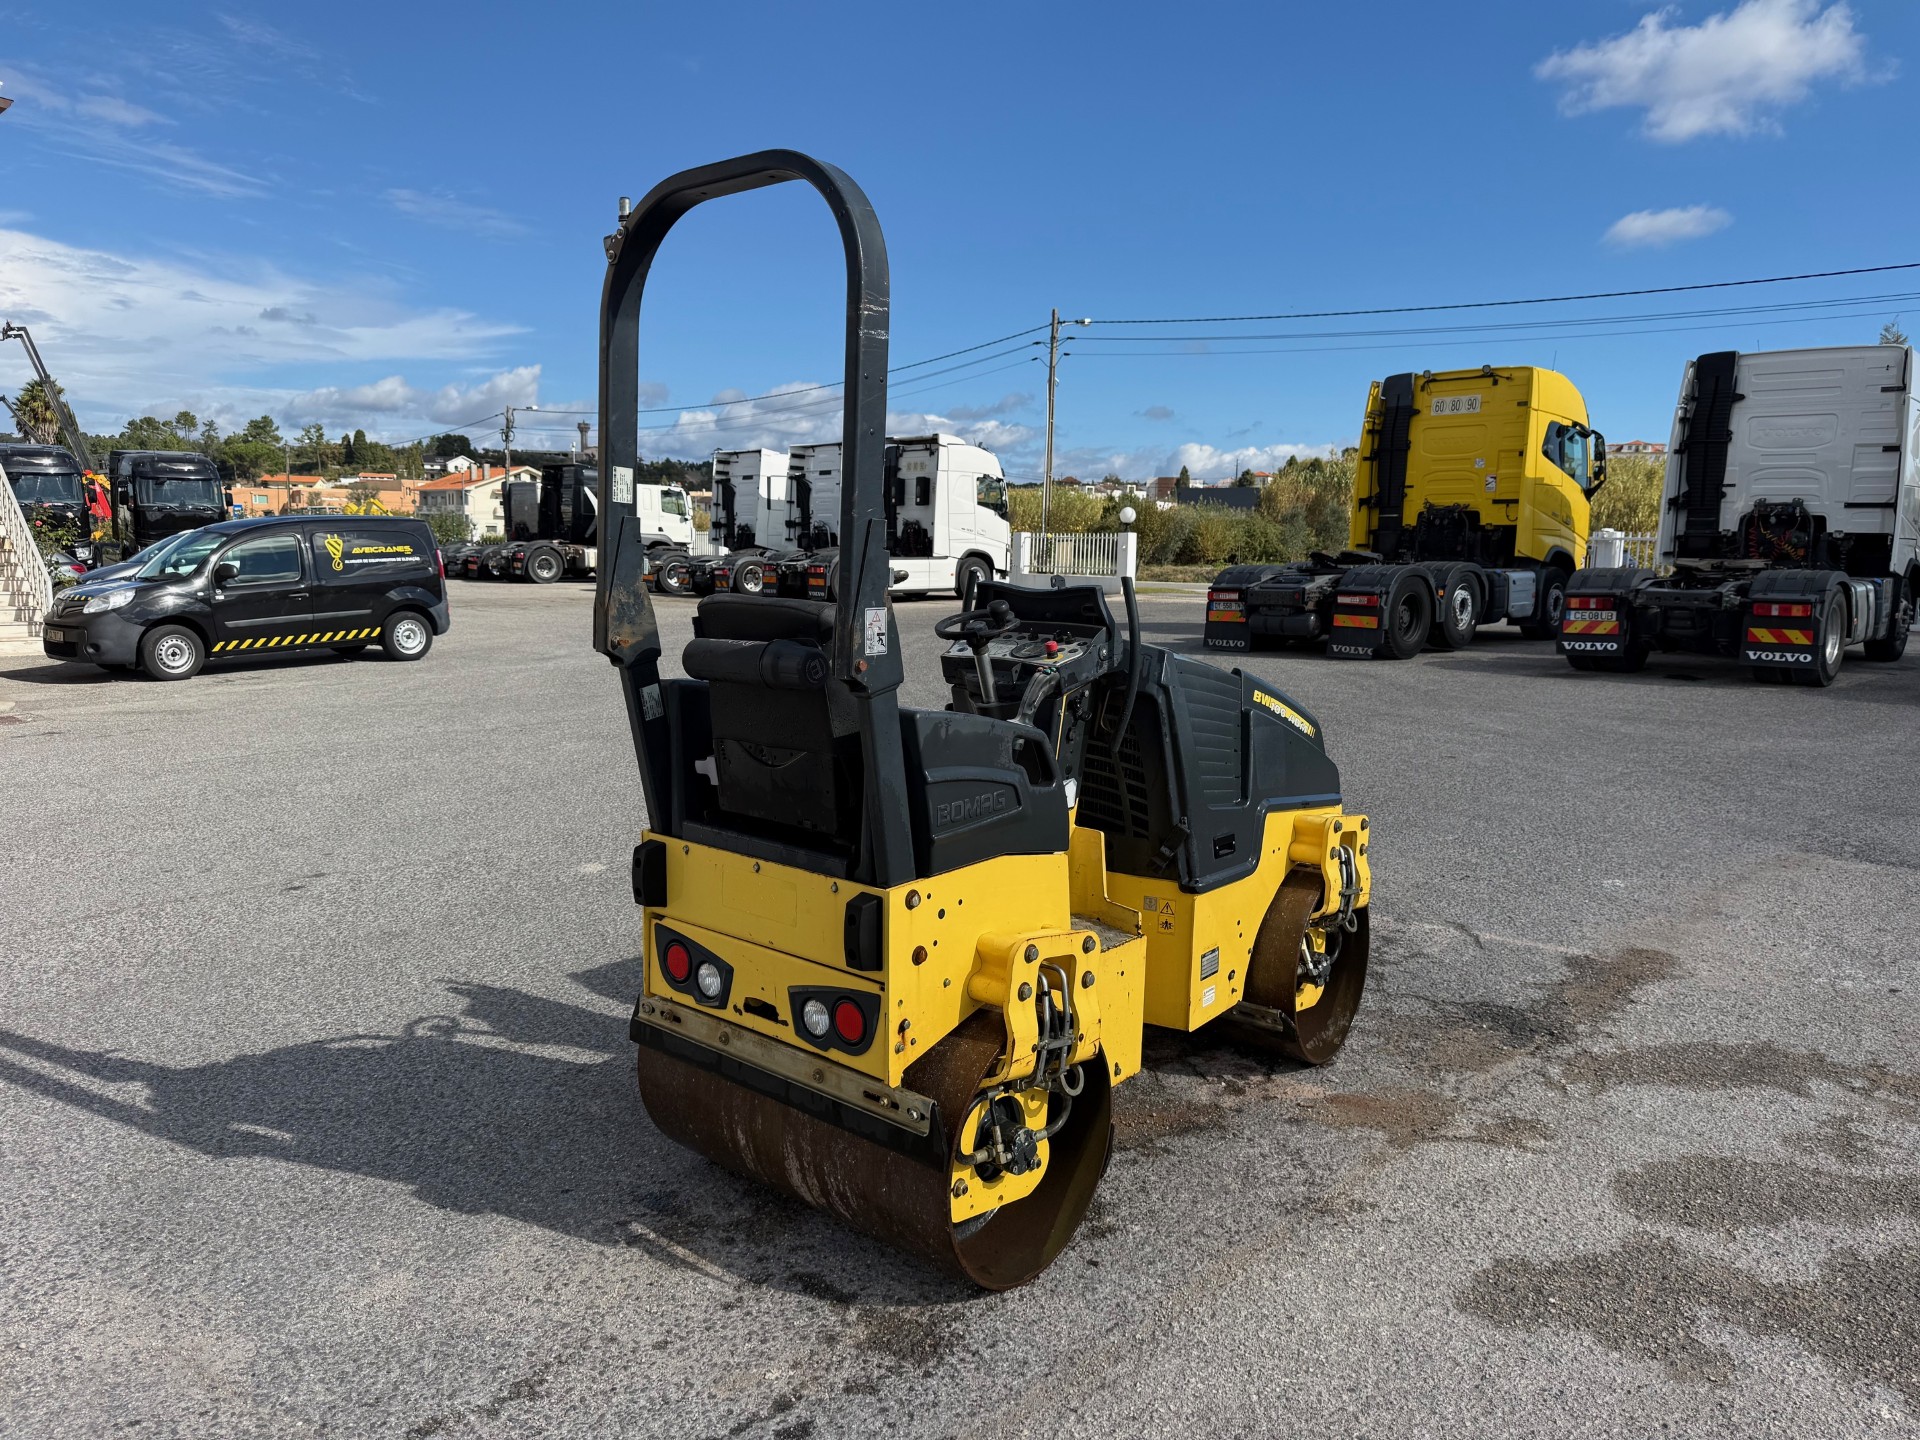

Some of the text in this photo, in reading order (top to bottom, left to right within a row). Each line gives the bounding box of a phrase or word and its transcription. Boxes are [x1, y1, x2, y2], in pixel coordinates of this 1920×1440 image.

[1434, 398, 1478, 413] 60 80 90
[1207, 638, 1245, 648] VOLVO
[1561, 641, 1618, 651] VOLVO
[1745, 650, 1812, 663] VOLVO
[937, 789, 1006, 827] BOMAG
